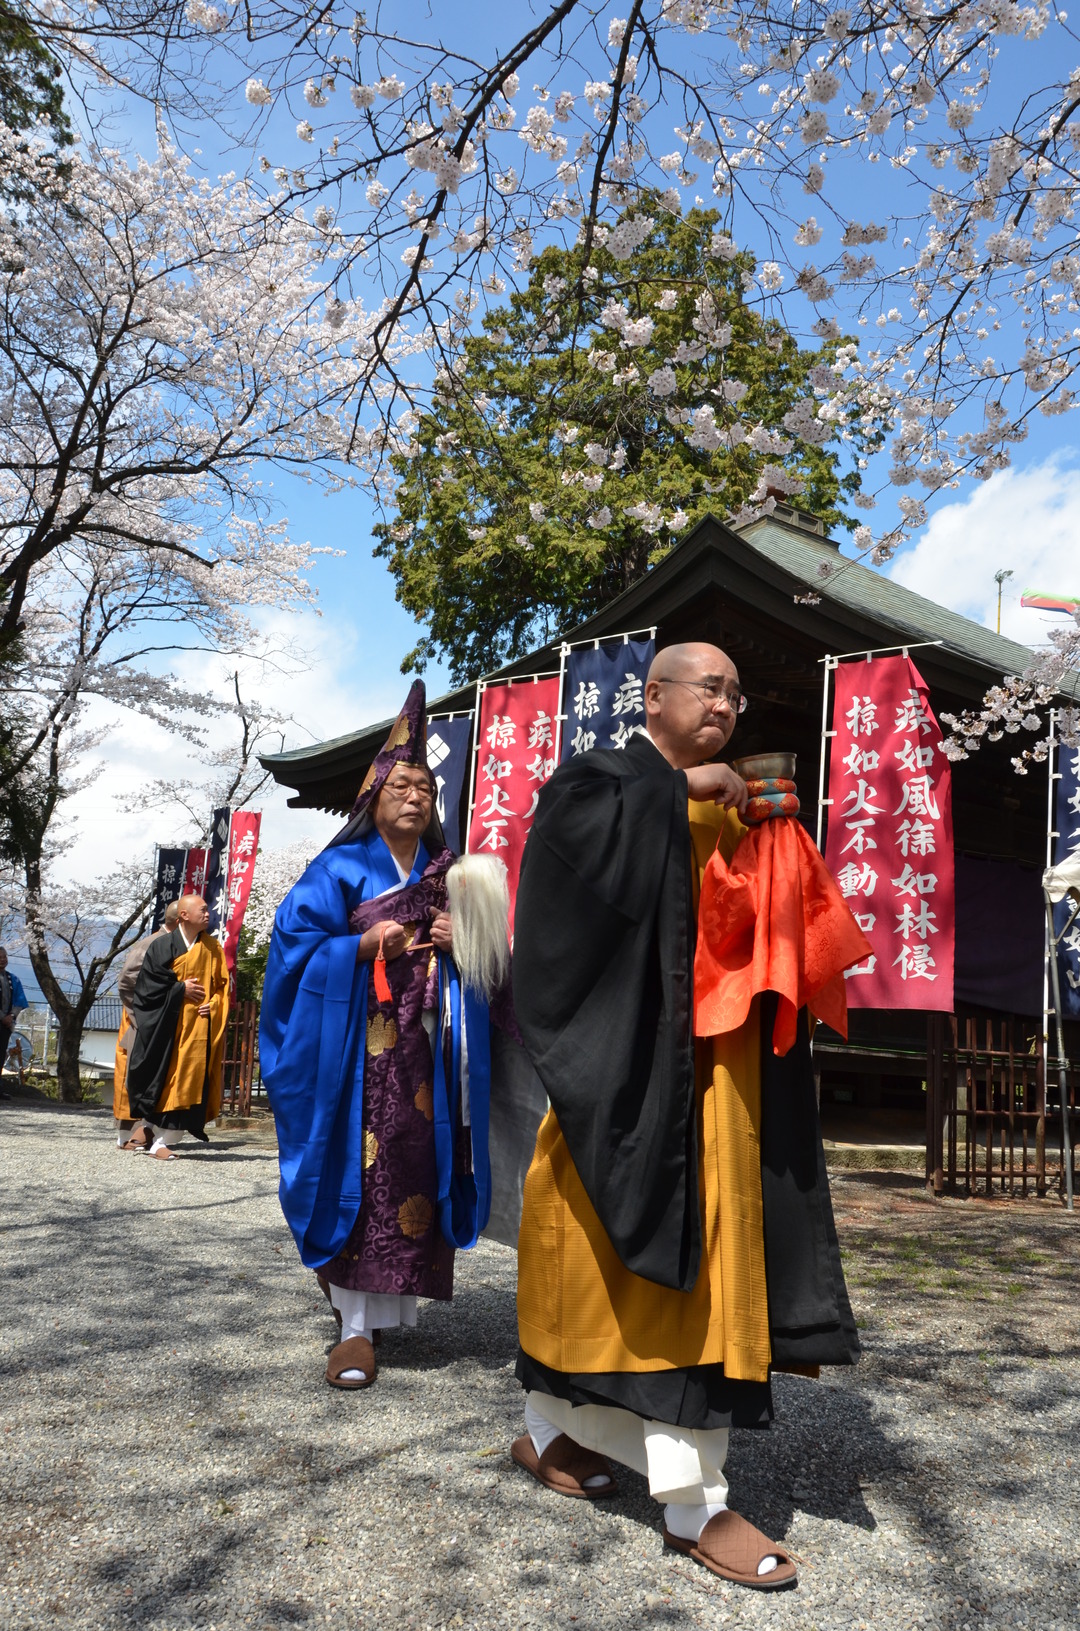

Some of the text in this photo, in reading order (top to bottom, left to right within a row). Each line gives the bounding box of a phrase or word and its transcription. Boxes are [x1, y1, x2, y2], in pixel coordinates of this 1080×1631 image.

[477, 715, 518, 882] 掠如火不
[571, 681, 601, 757] 掠如
[890, 688, 941, 981] 疾如風徐如林侵
